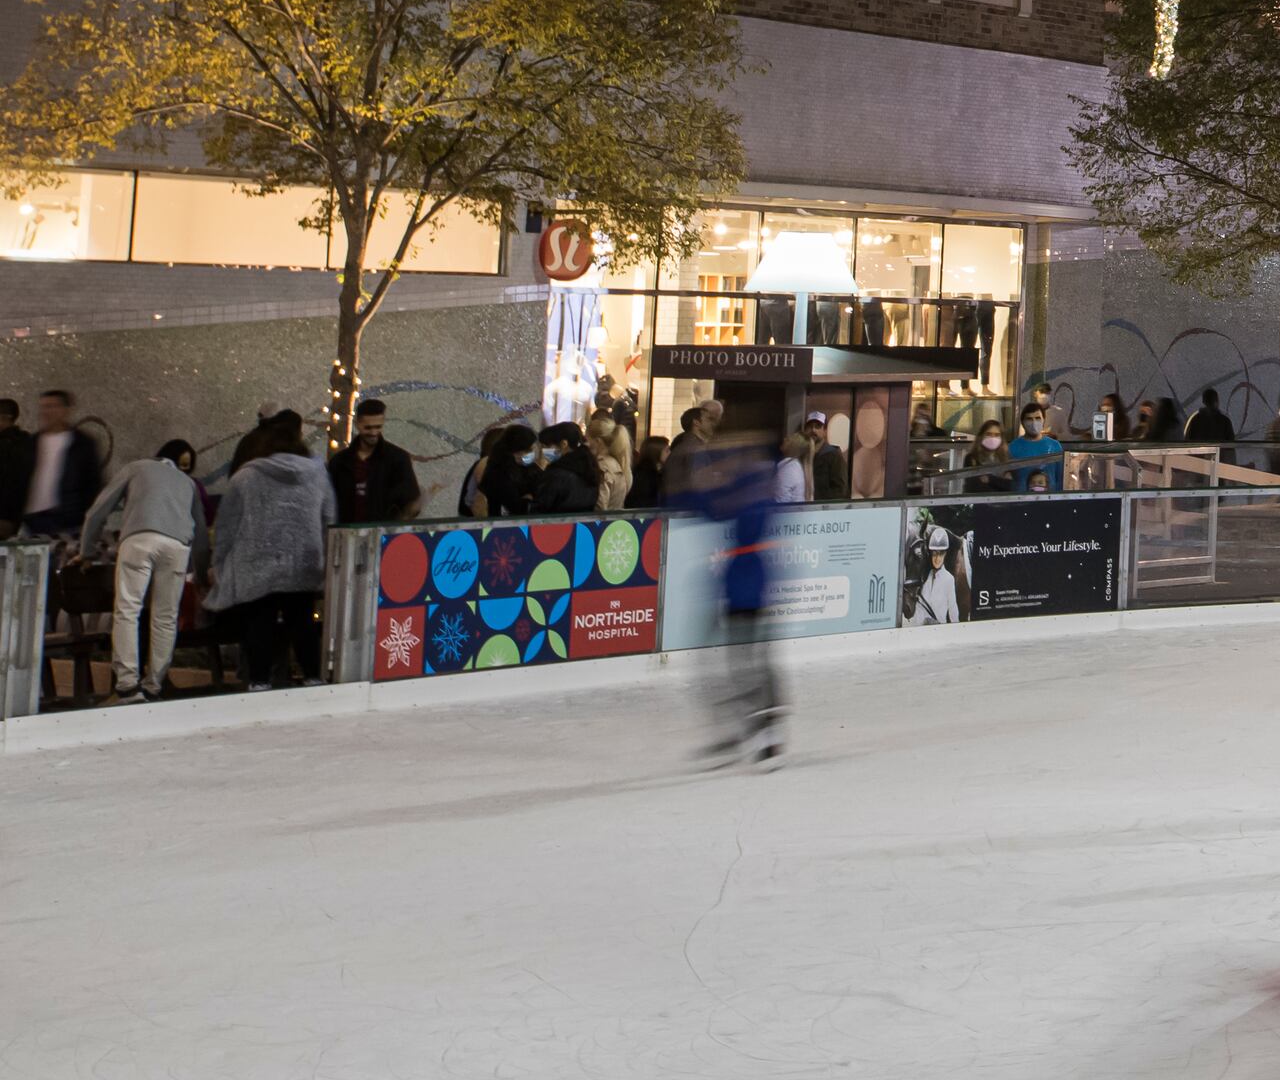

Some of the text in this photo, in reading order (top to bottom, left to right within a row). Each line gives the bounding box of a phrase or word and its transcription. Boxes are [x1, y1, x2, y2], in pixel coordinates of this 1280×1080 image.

[669, 350, 796, 368] PHOTO BOOTH
[783, 524, 801, 536] THE
[803, 523, 818, 535] ICE
[820, 521, 851, 534] ABOUT
[979, 539, 1101, 559] My Experience. Your Lifestyle.
[433, 546, 475, 582] Hope
[1105, 558, 1113, 601] COMPASS
[574, 608, 655, 629] NORTHSIDE
[588, 625, 639, 641] HOSPITAL
